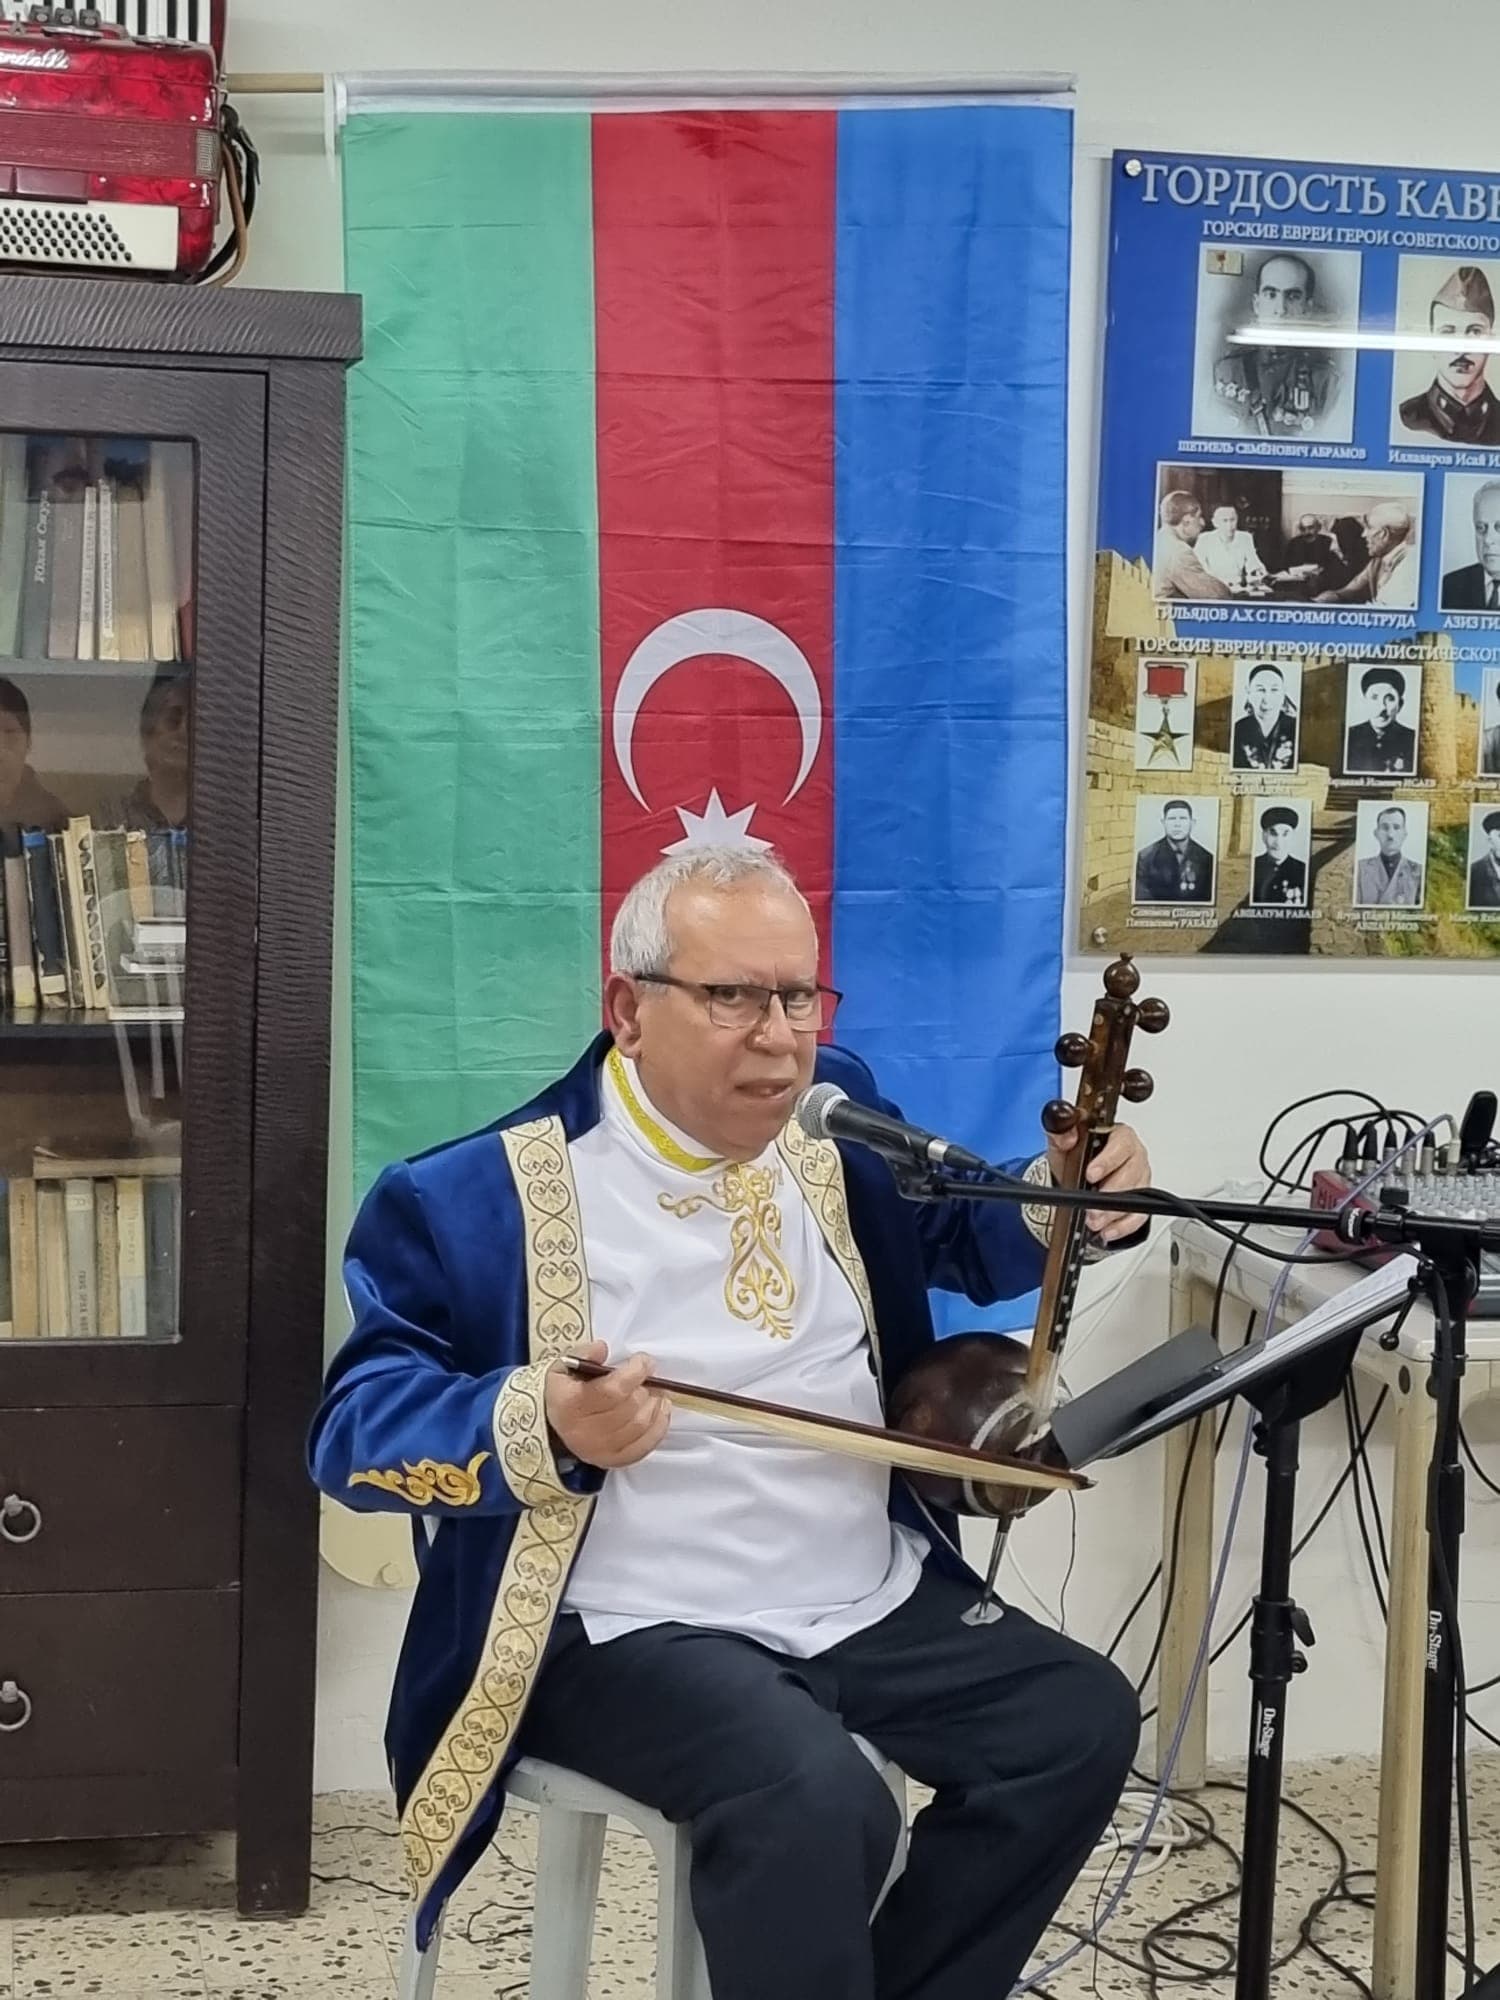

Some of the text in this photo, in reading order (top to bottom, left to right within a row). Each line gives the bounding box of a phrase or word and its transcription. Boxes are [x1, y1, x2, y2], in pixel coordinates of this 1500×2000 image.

[1142, 164, 1386, 217] ГОРДОСТЬ
[1203, 220, 1500, 251] ГОРСКИЕ ЕВРЕИ ГЕРОИ СОВЕТСКОГО
[1310, 446, 1367, 460] АБРАМОВ
[1156, 606, 1228, 622] ГИЛЬЯДОВ
[1268, 611, 1335, 625] ГЕРОЯМИ
[1443, 615, 1479, 630] АЗИЗ
[1136, 637, 1211, 653] ГОРСКИЕ
[1213, 640, 1264, 655] ЕВРЕИ
[1267, 641, 1320, 658] ГЕРОИ
[1426, 1609, 1442, 1673] On-Stage
[1258, 1707, 1276, 1760] On-Stage
